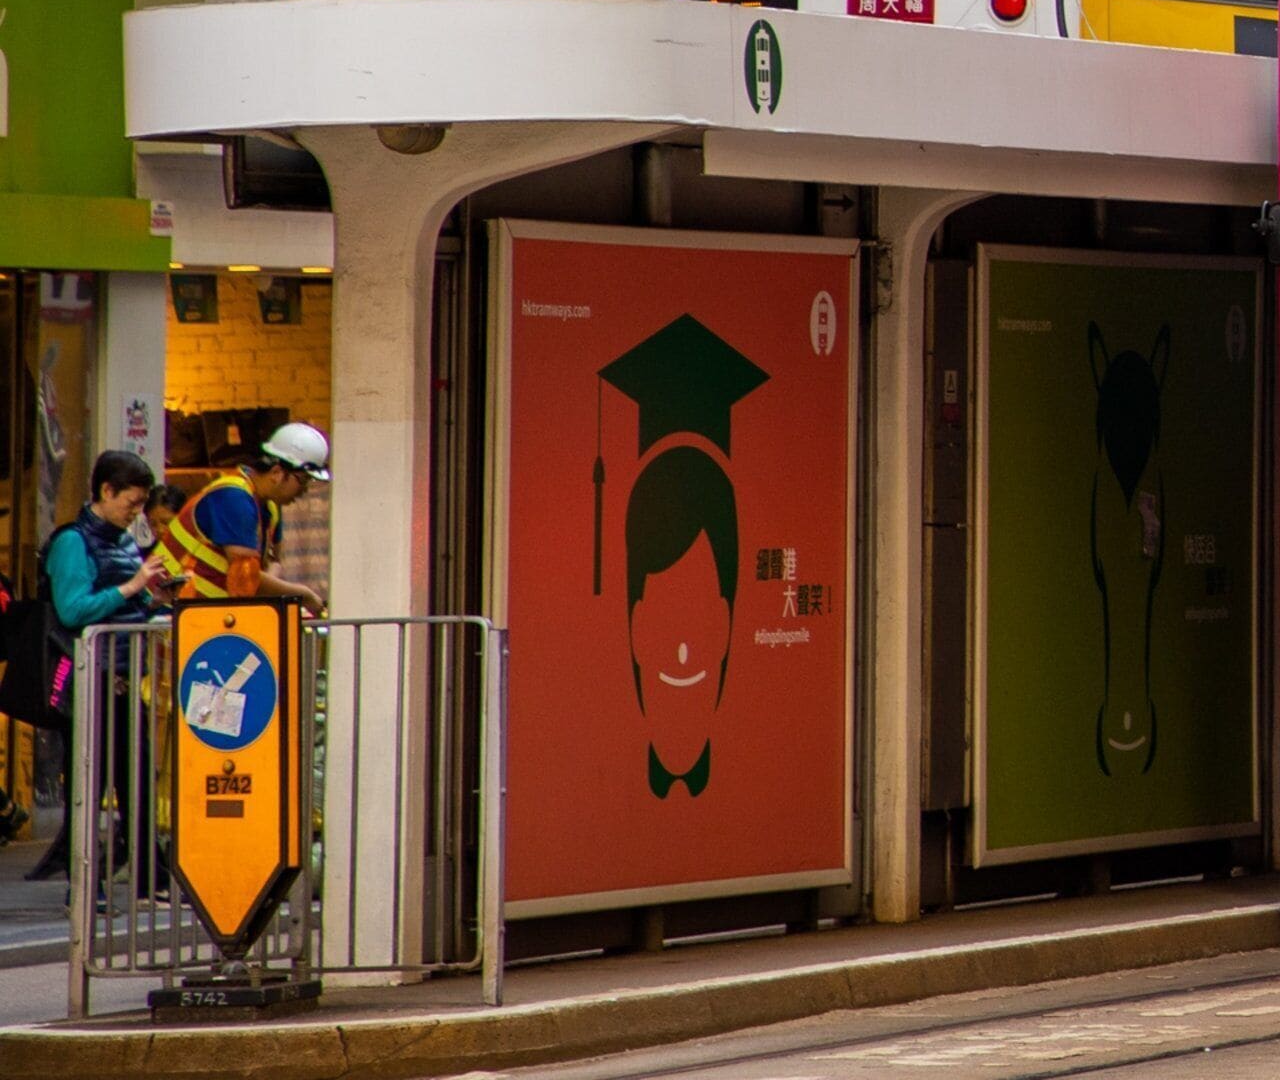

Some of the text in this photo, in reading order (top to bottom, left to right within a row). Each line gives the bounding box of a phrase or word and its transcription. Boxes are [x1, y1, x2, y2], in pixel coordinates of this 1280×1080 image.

[521, 299, 591, 322] hktramways.com
[755, 627, 810, 649] #dingdingsmile
[206, 774, 252, 795] B742
